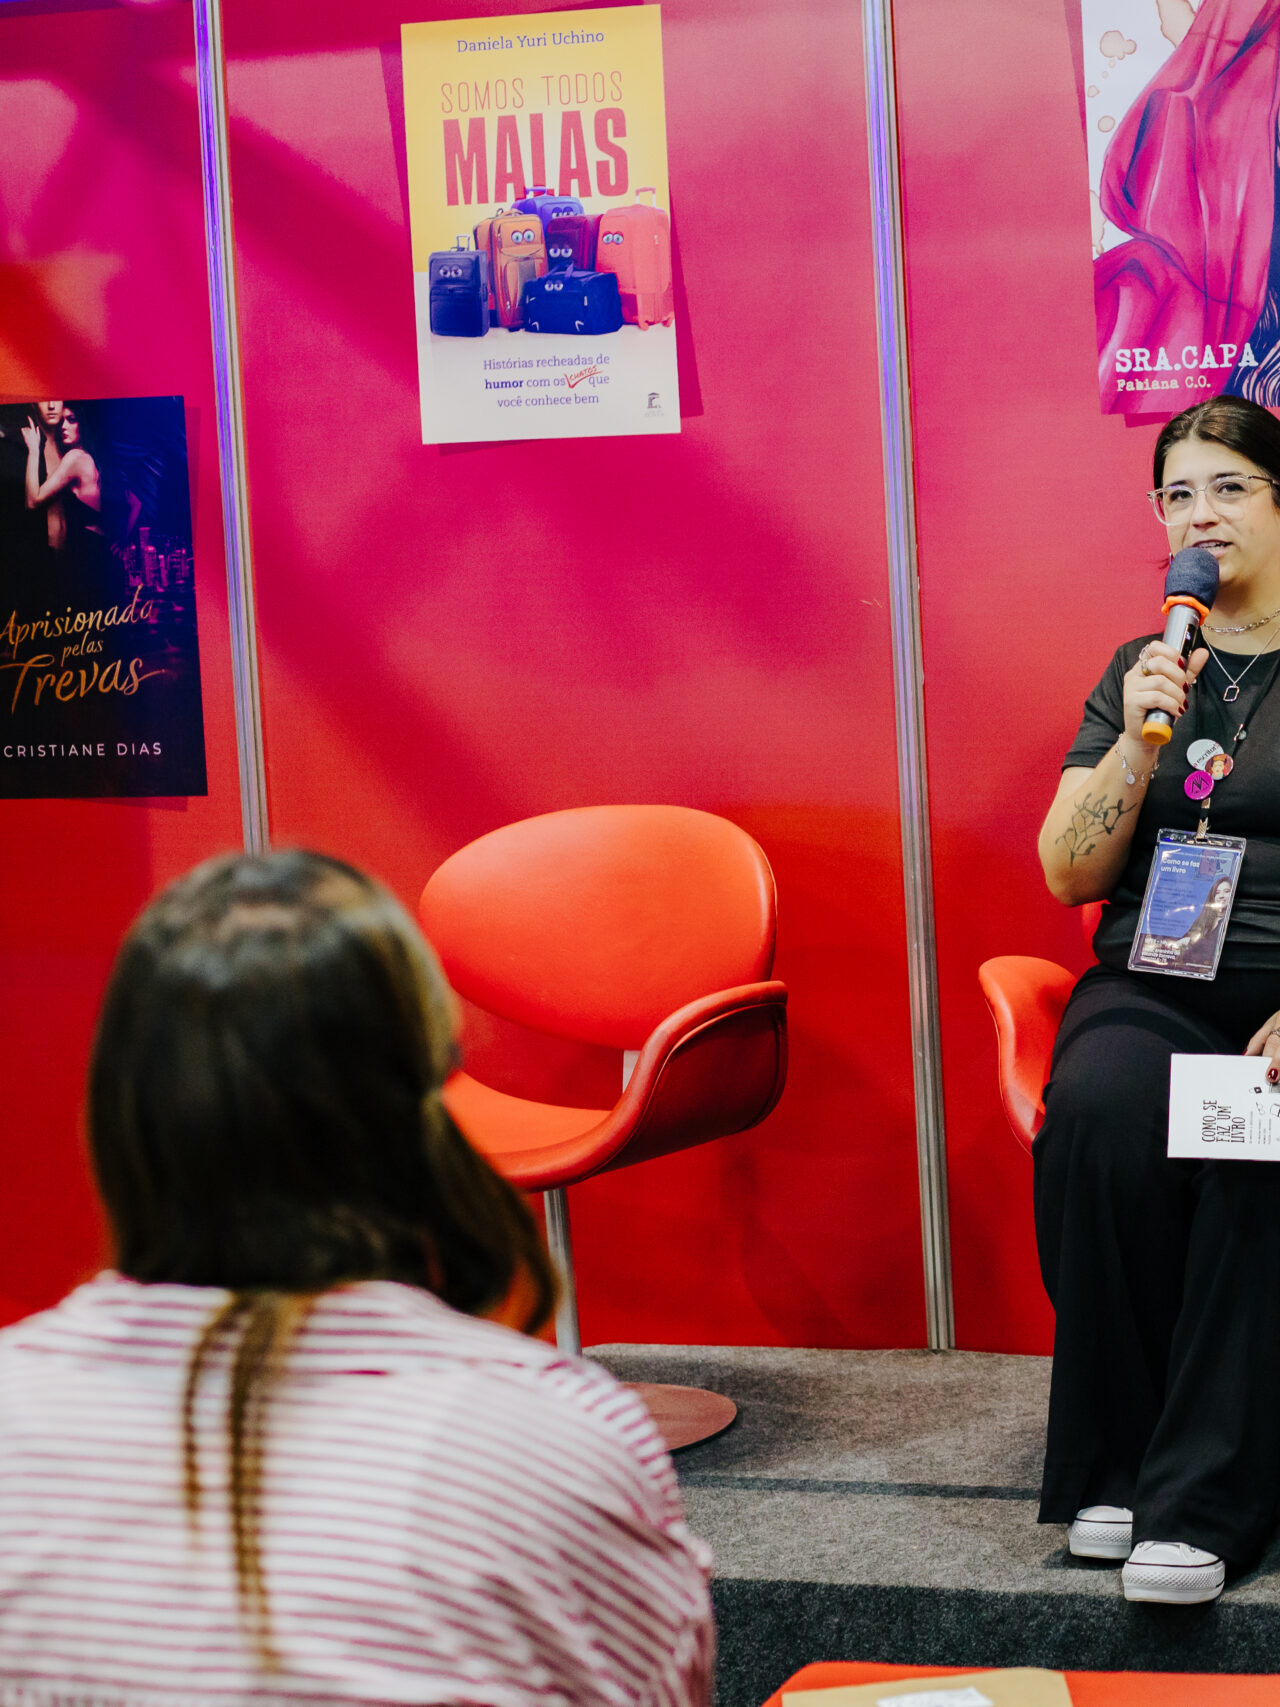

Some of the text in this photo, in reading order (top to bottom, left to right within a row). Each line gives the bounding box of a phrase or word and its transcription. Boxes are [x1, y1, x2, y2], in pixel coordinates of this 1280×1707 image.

[457, 30, 604, 53] Daniela Yuri Uchino
[441, 70, 623, 113] SOMOS TODOS
[442, 107, 629, 206] MALAS
[483, 353, 610, 371] Histórias recheadas de
[1115, 342, 1259, 373] SRA.CAPA
[485, 375, 610, 389] humor com os que
[1116, 375, 1211, 392] Fabiana C.O.
[497, 392, 599, 408] você conhece bem
[0, 583, 154, 660] Aprisionada
[61, 631, 104, 668] pelas
[0, 654, 166, 715] Trevas
[4, 742, 162, 758] CRISTIANE DIAS
[1202, 1099, 1217, 1143] COMO SE
[1216, 1105, 1231, 1142] FAZ UM
[1230, 1116, 1246, 1143] LIVRO
